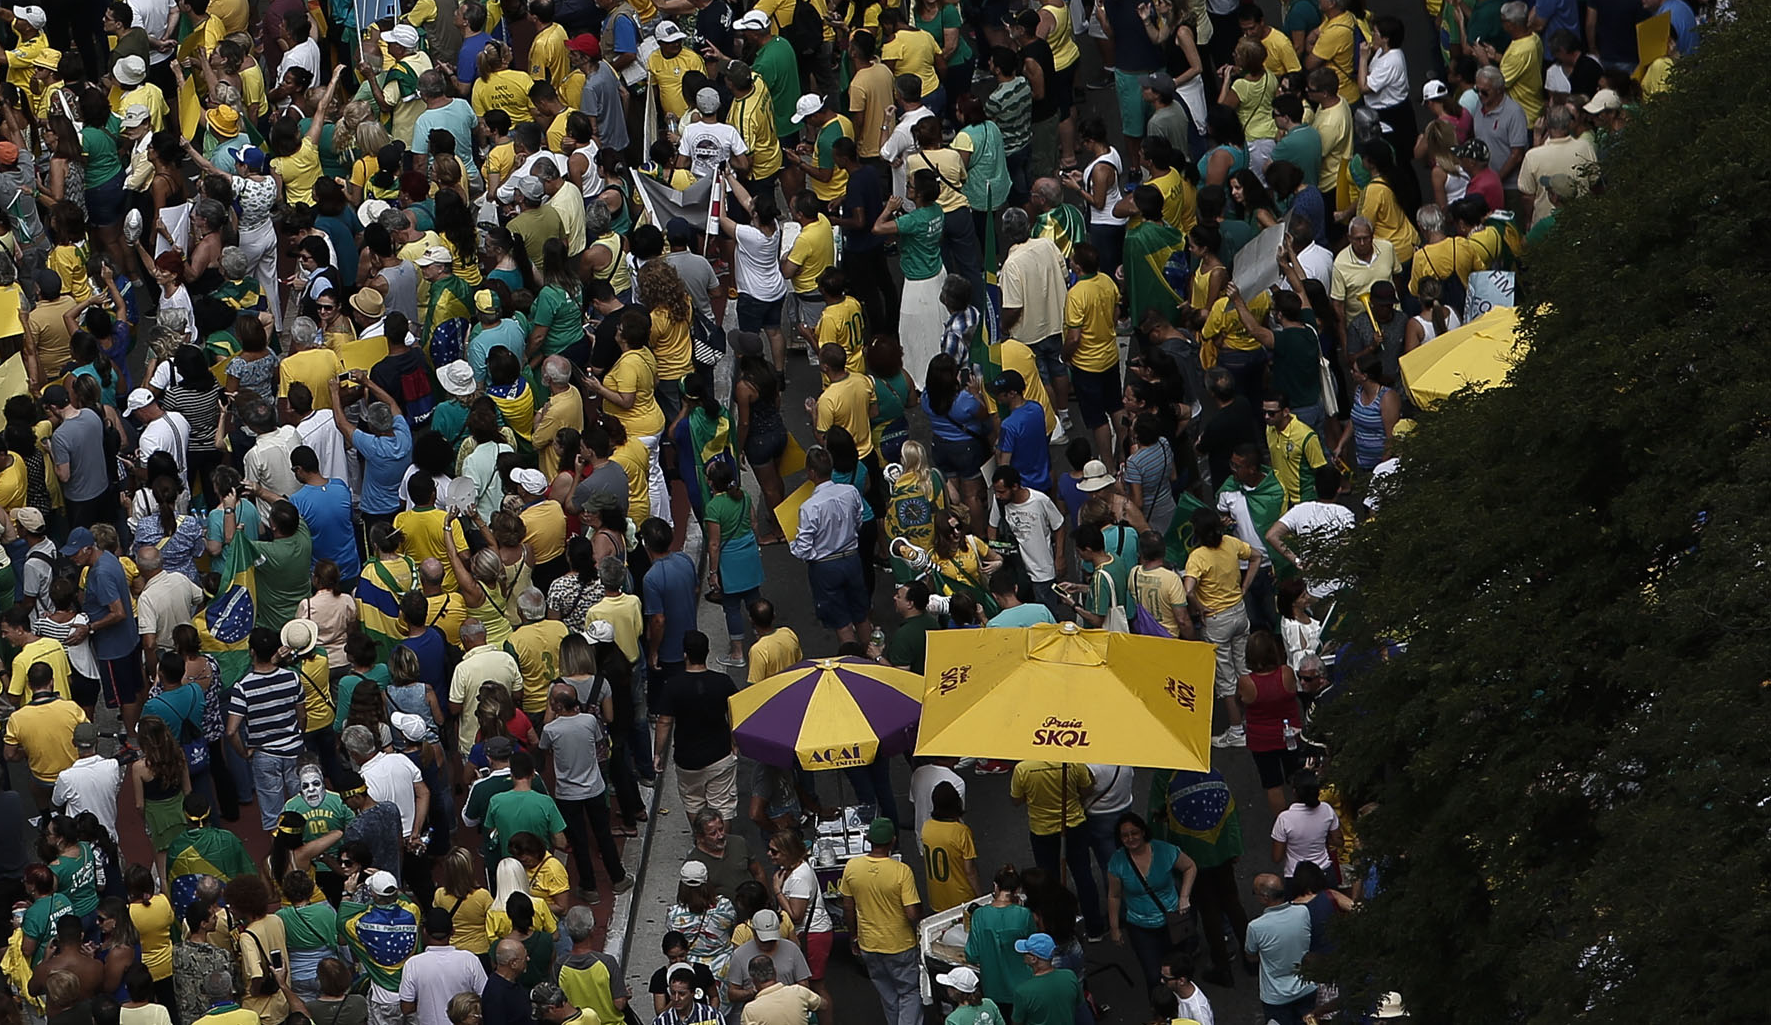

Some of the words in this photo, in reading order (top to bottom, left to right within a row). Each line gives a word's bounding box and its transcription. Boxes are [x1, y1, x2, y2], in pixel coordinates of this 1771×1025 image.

[541, 651, 556, 681] 3
[1042, 716, 1083, 729] Praia
[1032, 729, 1091, 749] SKOL
[808, 742, 862, 767] AÇAÍ
[922, 843, 950, 883] 10
